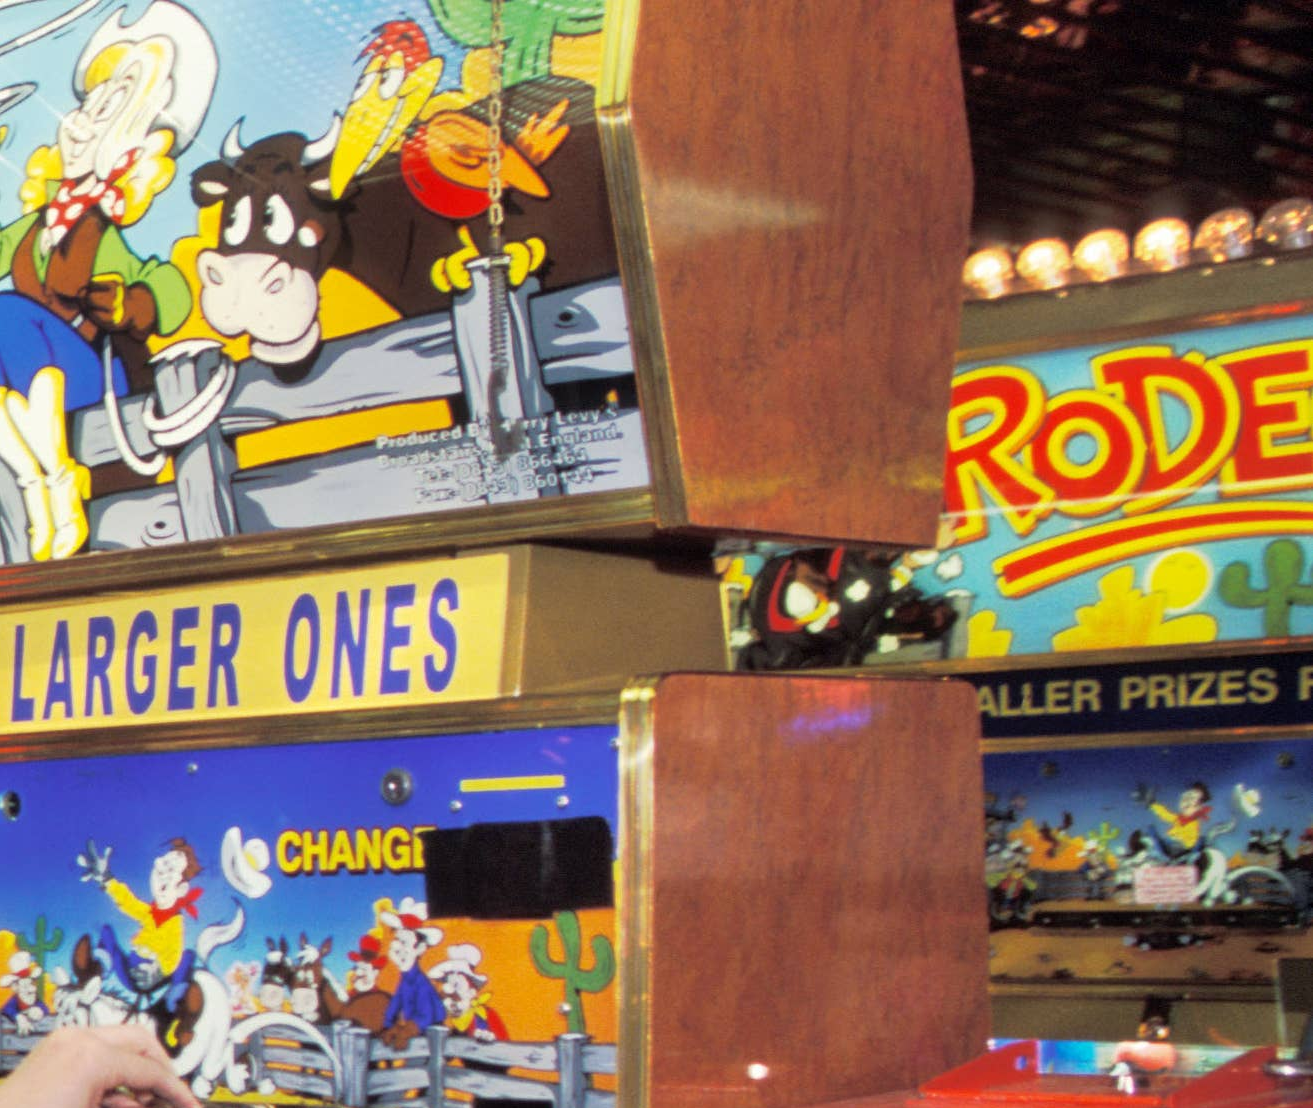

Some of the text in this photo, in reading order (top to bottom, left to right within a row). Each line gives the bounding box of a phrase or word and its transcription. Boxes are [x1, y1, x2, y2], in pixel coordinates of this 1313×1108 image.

[11, 603, 242, 723] LARGER
[285, 577, 460, 702] ONES
[1120, 668, 1278, 710] PRIZES
